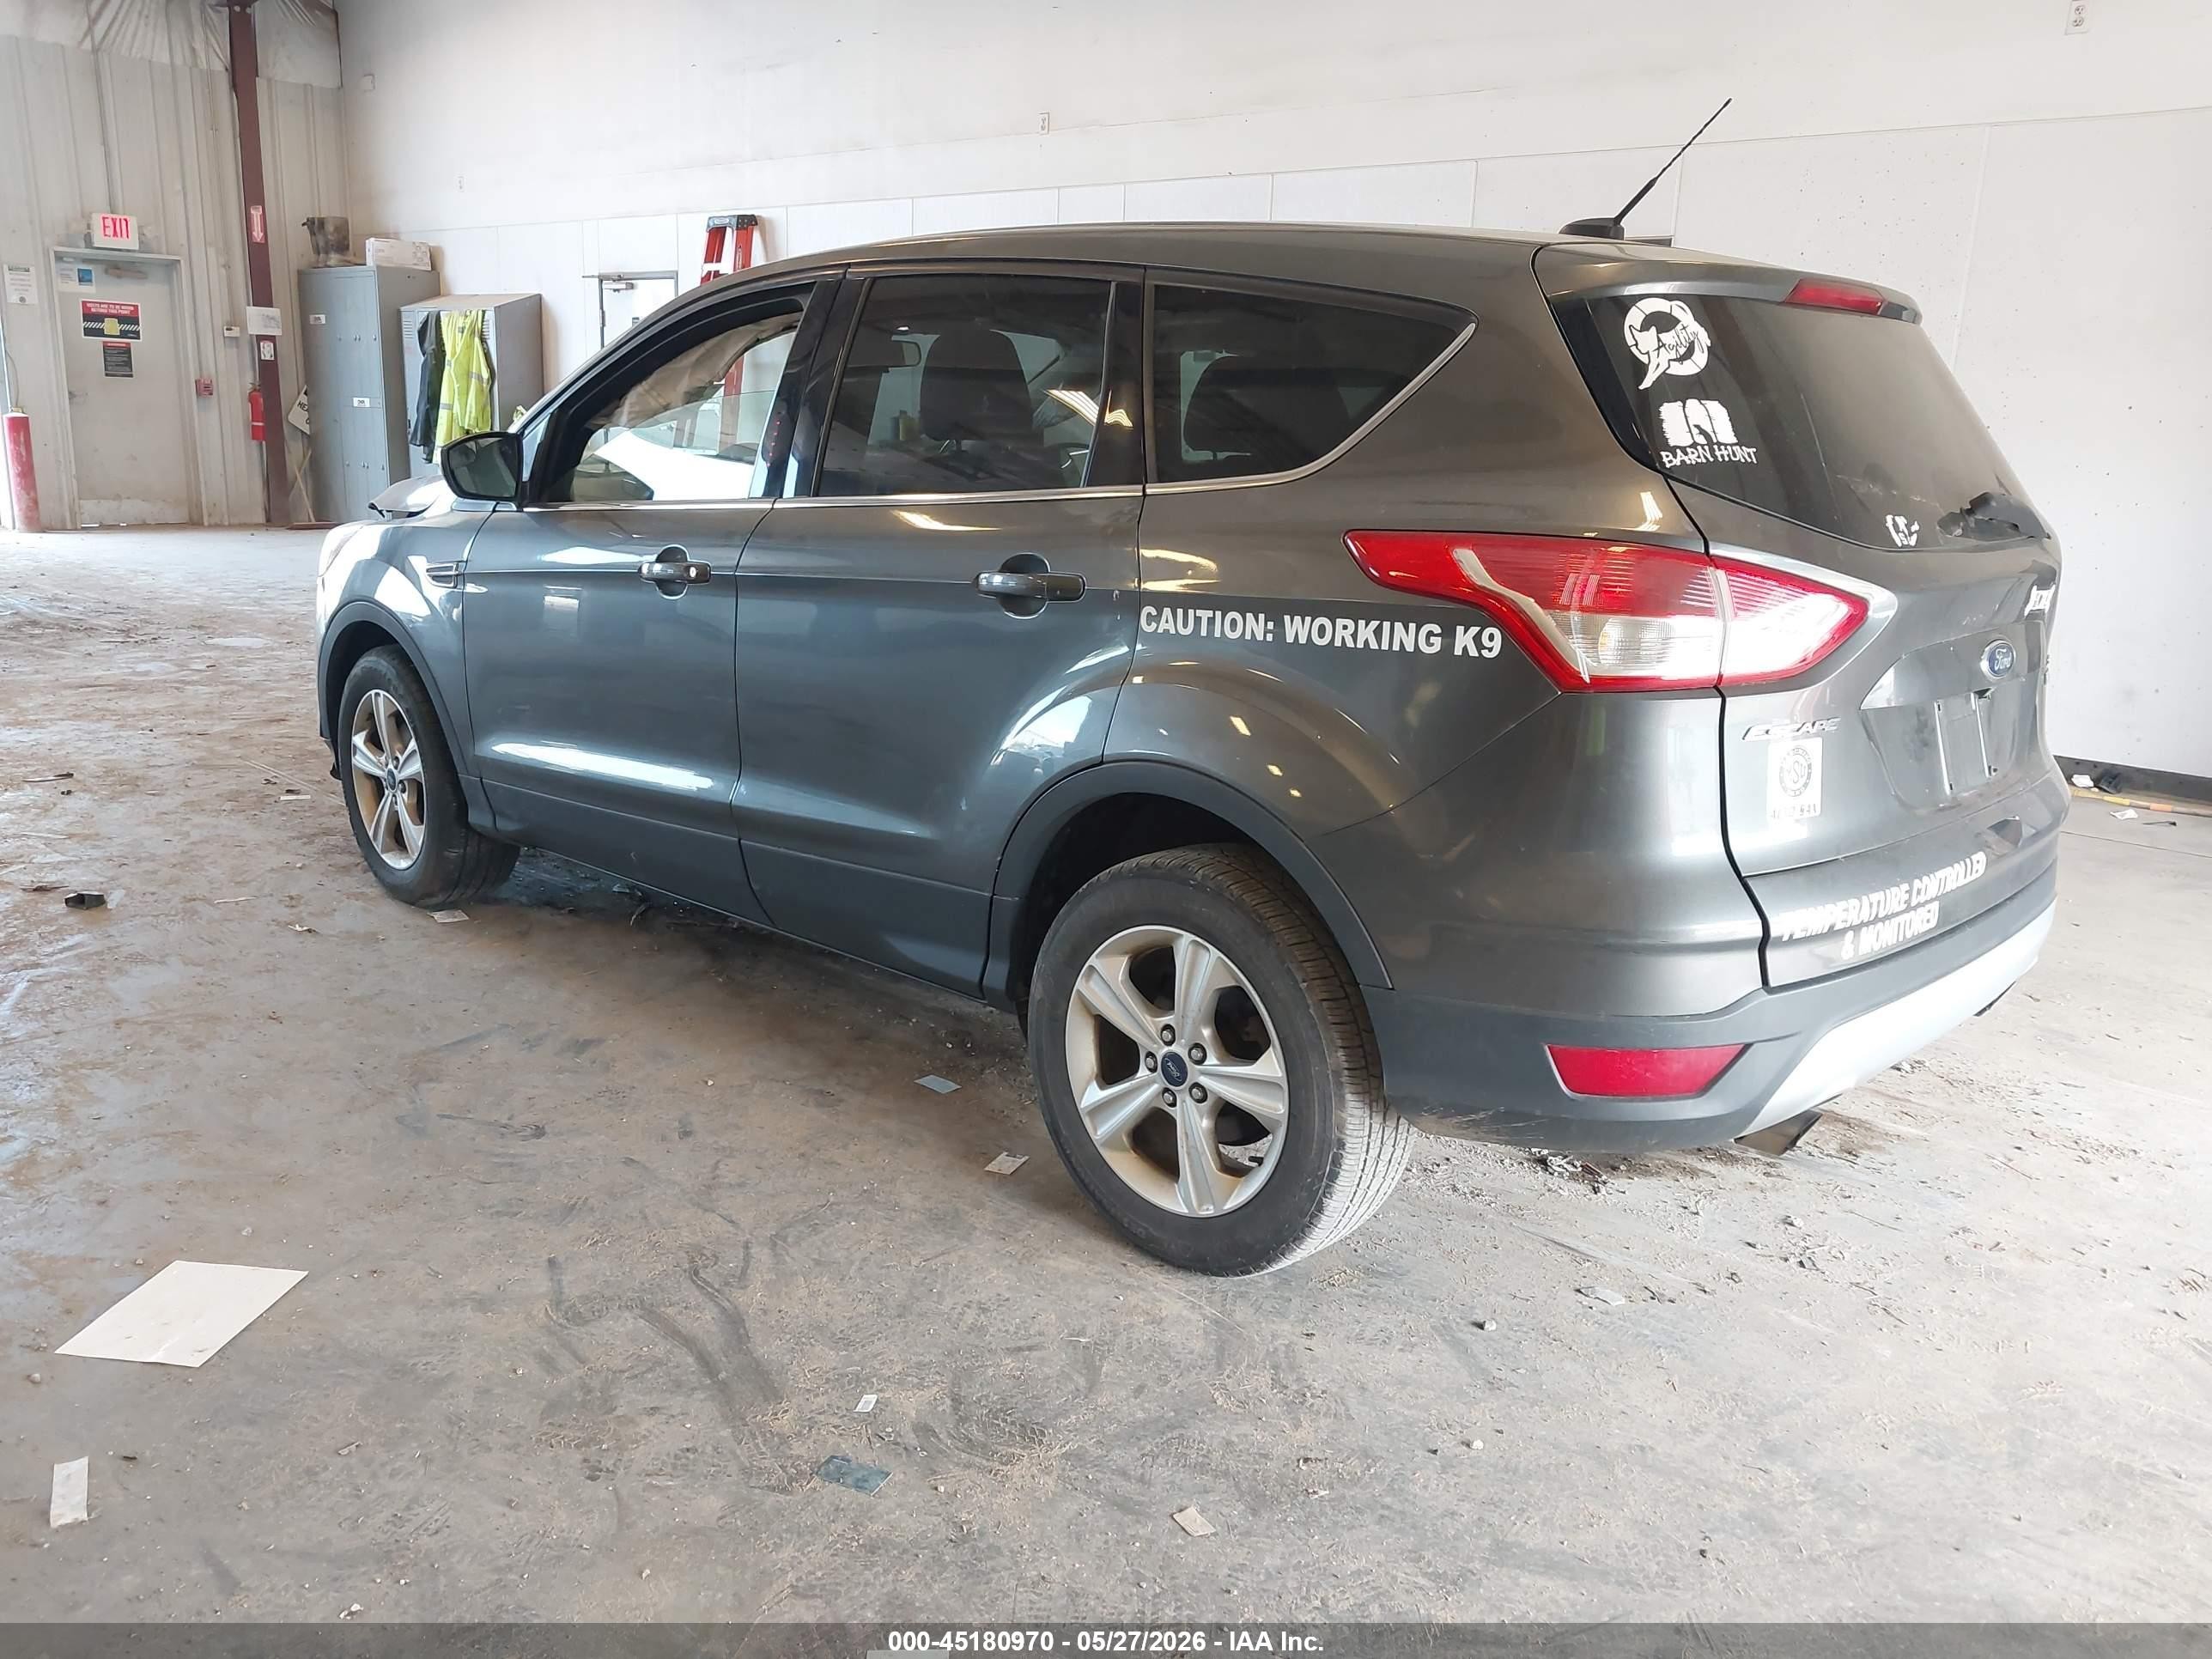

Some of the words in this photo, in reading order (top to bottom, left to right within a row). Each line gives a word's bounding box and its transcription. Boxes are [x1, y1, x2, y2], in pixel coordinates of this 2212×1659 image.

[102, 216, 130, 239] EXIT
[1652, 323, 1705, 364] Agility
[1661, 447, 1714, 469] BARN
[1714, 445, 1758, 465] HUNT
[1139, 605, 1274, 642] CAUTION:
[1283, 614, 1443, 654] WORKING
[1453, 624, 1503, 659] K9
[1994, 647, 2013, 672] Ford
[1780, 882, 1911, 942] TEMPERATURE
[1911, 851, 1987, 908] CONTROLLED
[1840, 930, 1855, 960] &
[1858, 900, 1940, 956] MONITORED
